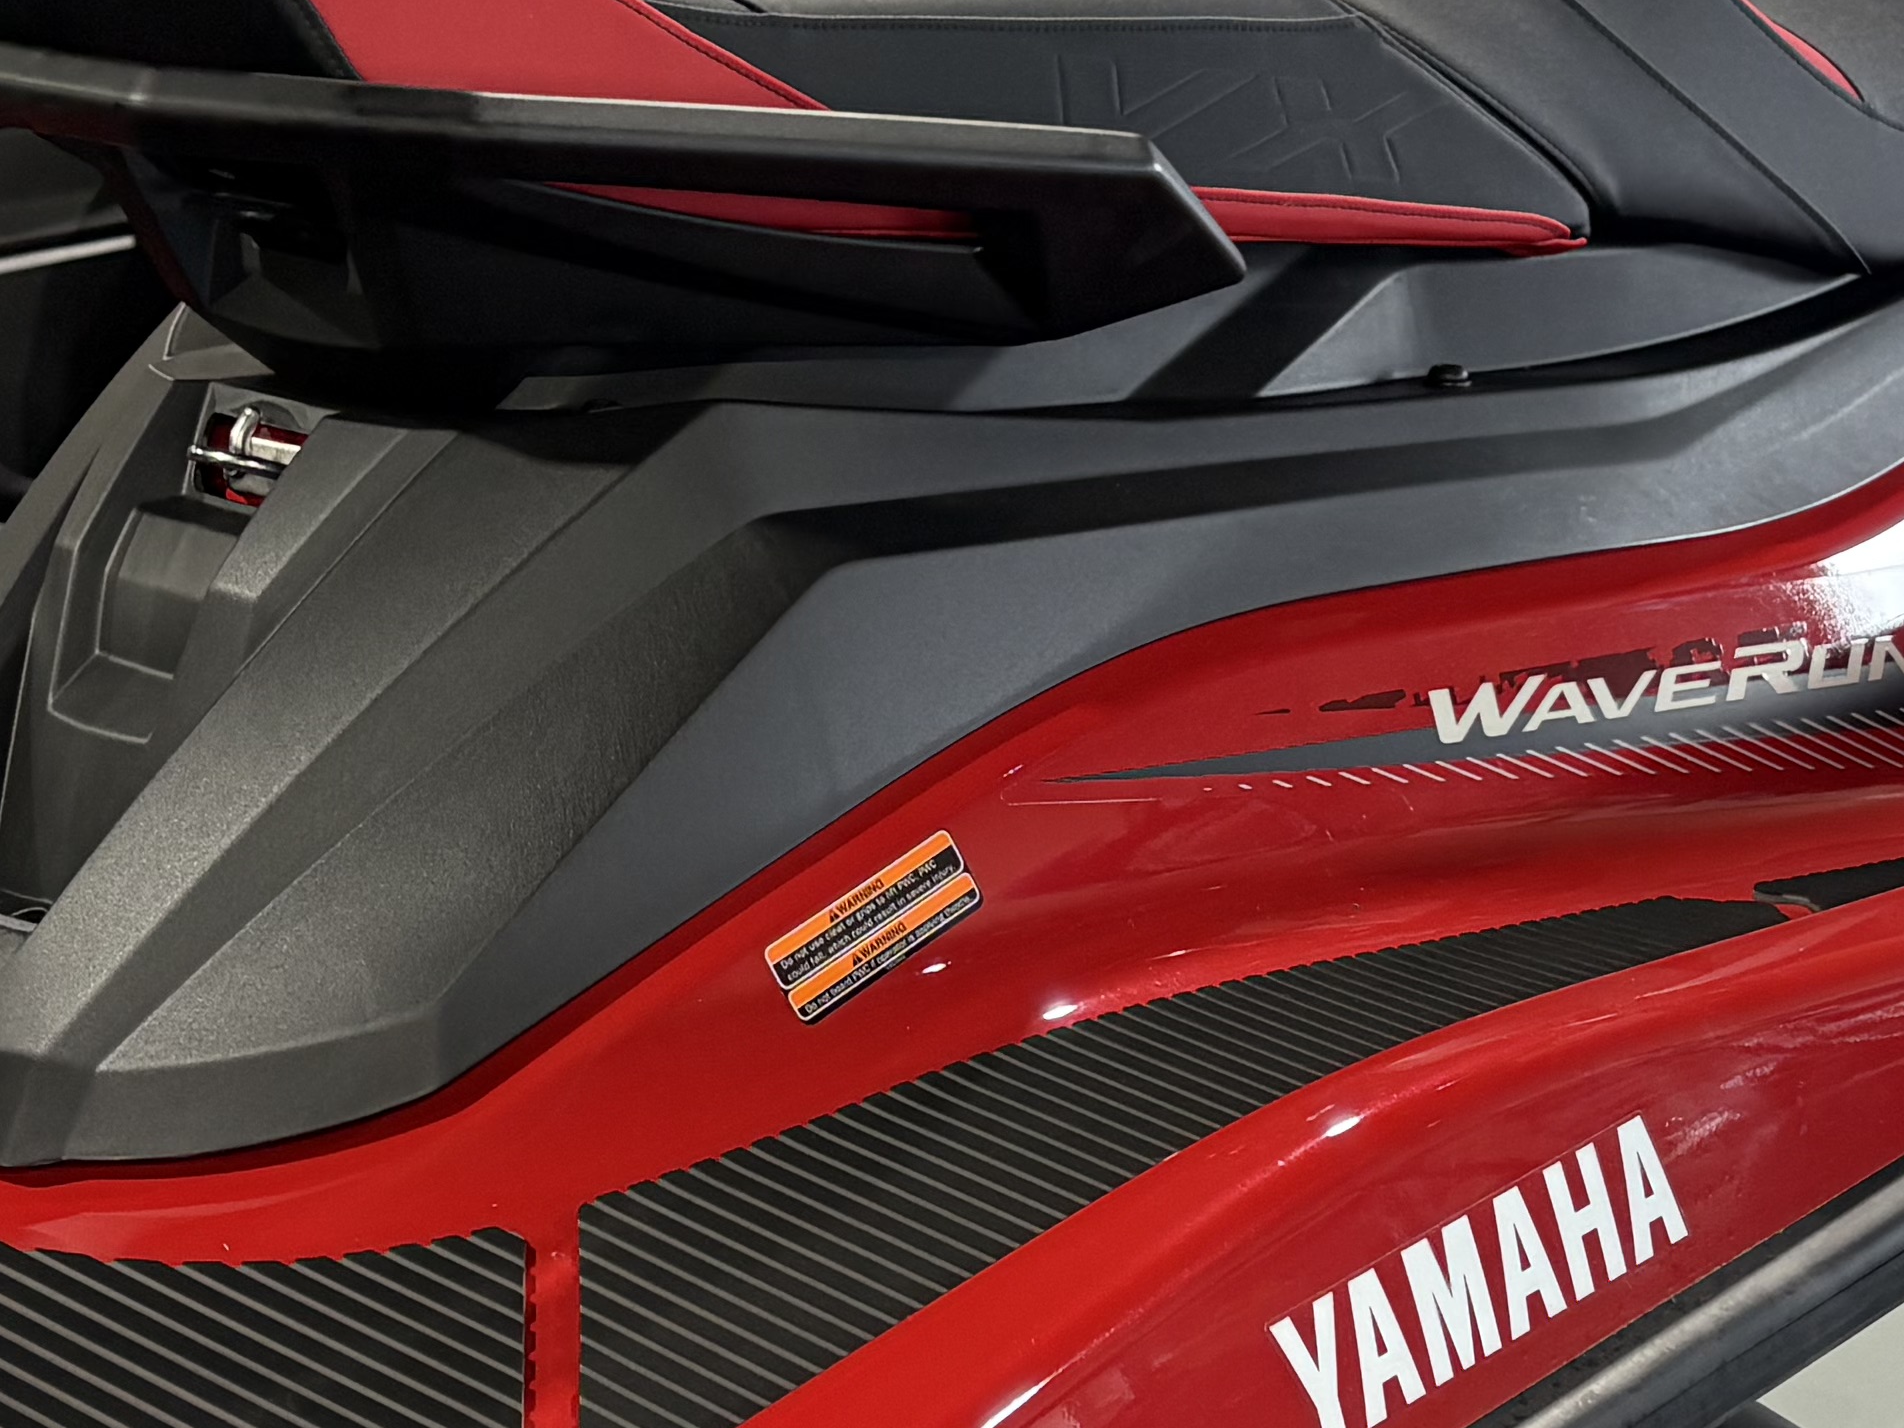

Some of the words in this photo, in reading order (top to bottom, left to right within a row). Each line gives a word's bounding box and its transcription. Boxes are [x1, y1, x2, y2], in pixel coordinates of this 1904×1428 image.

[780, 956, 795, 969] Do
[792, 946, 810, 961] not
[807, 936, 825, 951] use
[823, 921, 846, 941] cleat
[844, 915, 856, 927] or
[853, 901, 877, 922] grips
[874, 895, 886, 906] to
[883, 886, 898, 900] lift
[916, 859, 937, 877] PWC
[835, 877, 886, 916] WARNING
[785, 960, 811, 981] could
[825, 932, 852, 954] which
[849, 917, 874, 938] could
[871, 901, 898, 922] result
[895, 895, 906, 906] in
[904, 879, 932, 901] severe
[858, 921, 908, 959] WARNING
[804, 1000, 818, 1014] Do
[815, 991, 832, 1006] not
[828, 975, 853, 996] board
[850, 963, 872, 981] PWC
